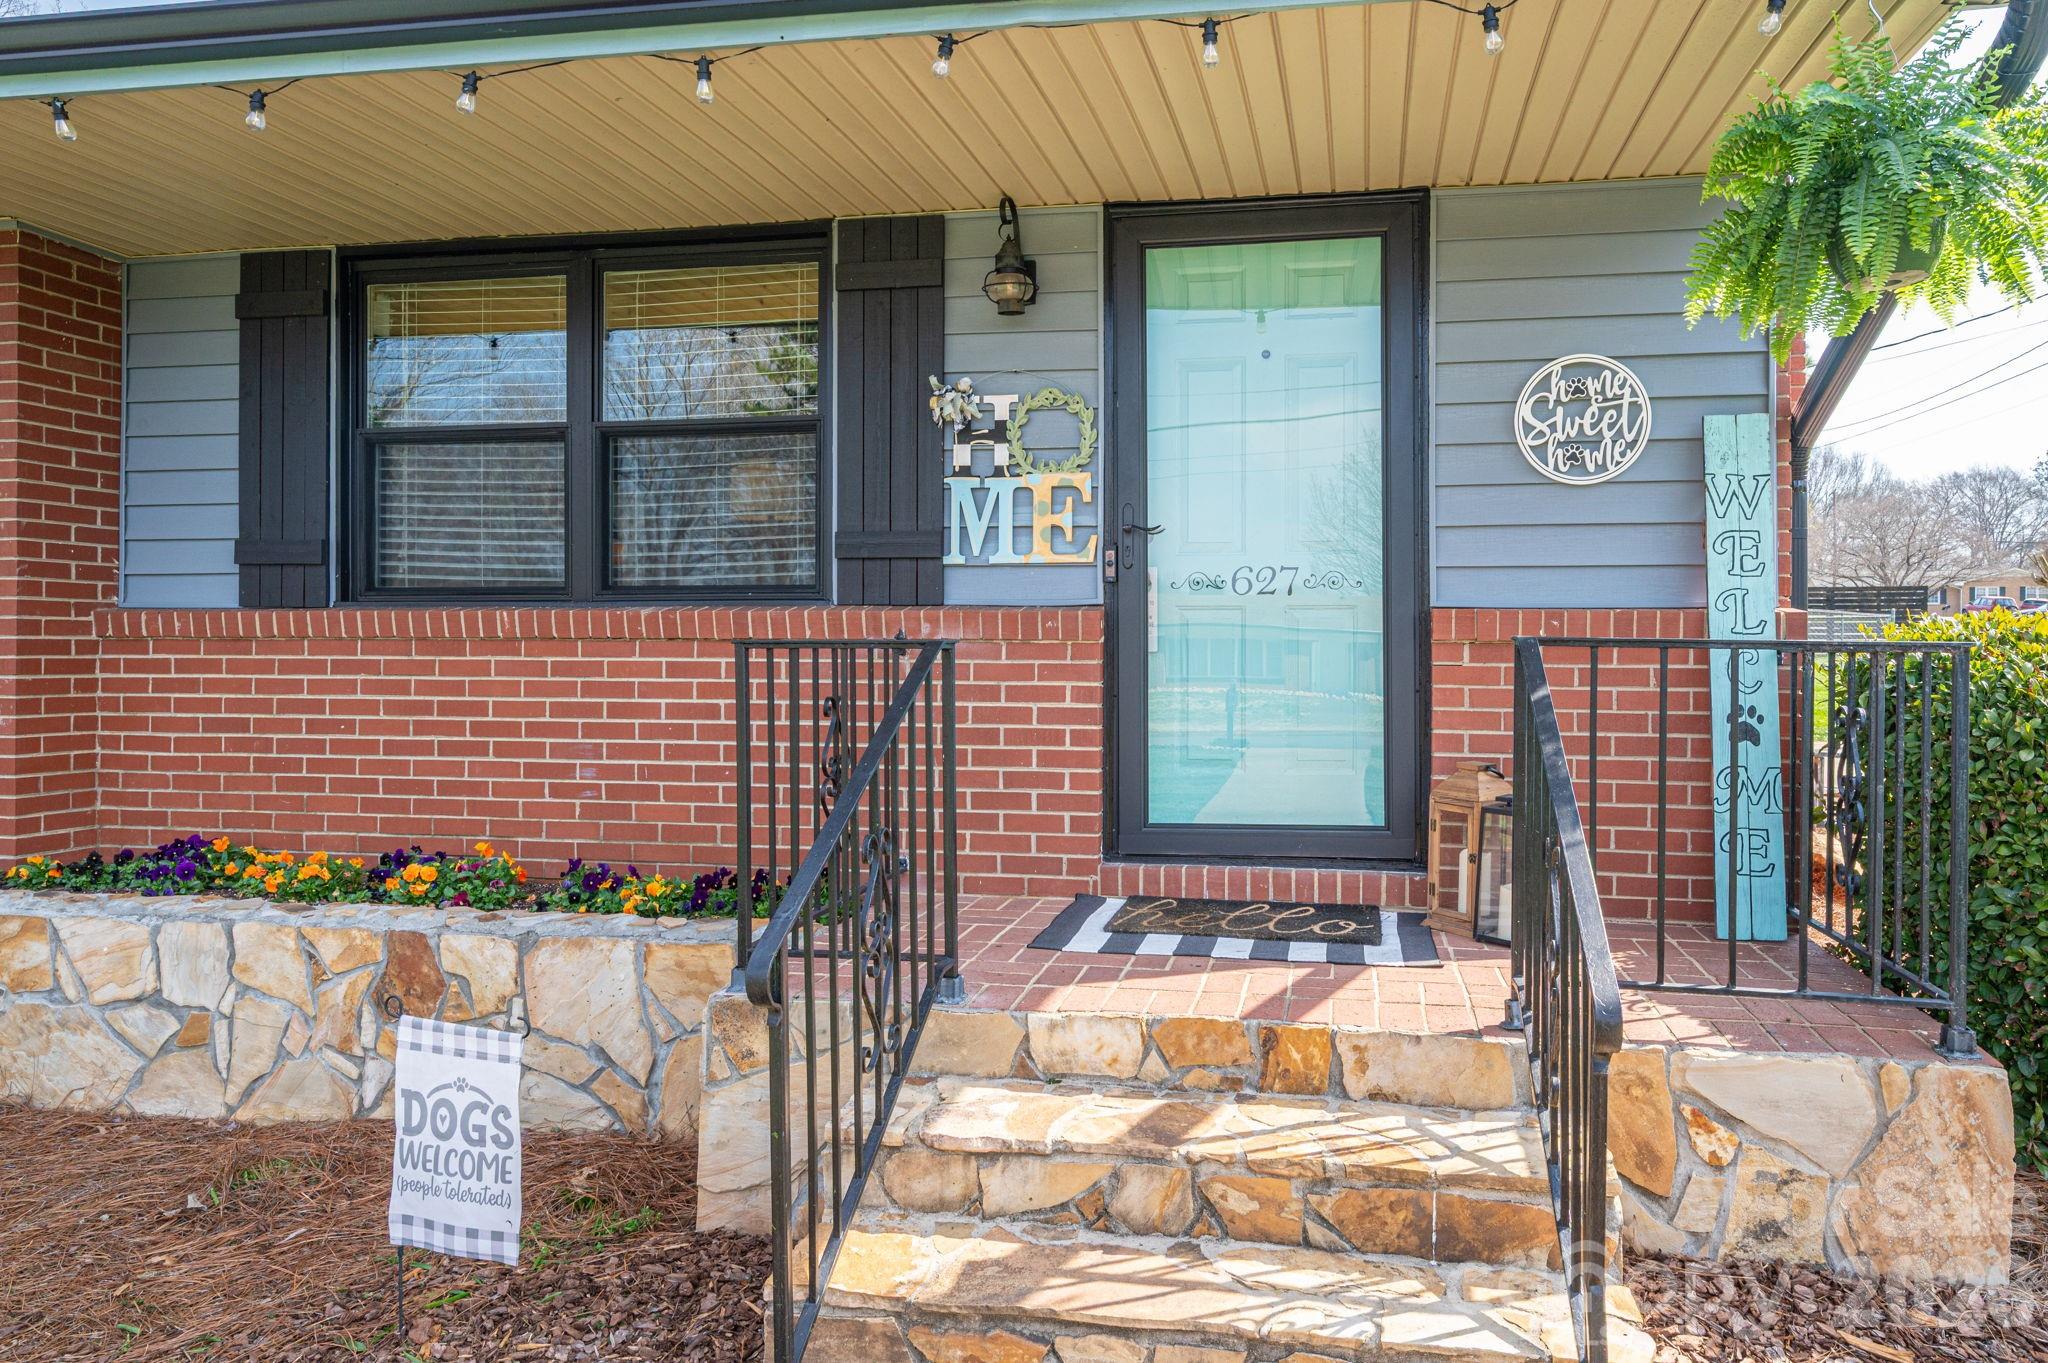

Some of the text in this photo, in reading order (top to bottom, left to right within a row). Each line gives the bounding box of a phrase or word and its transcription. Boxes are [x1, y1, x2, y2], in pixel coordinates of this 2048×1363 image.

[943, 473, 1098, 564] ME
[1231, 565, 1299, 596] 627
[1113, 899, 1375, 935] hello
[400, 1088, 515, 1150] DOGS
[399, 1138, 513, 1184] WELCOME
[396, 1174, 442, 1200] (people
